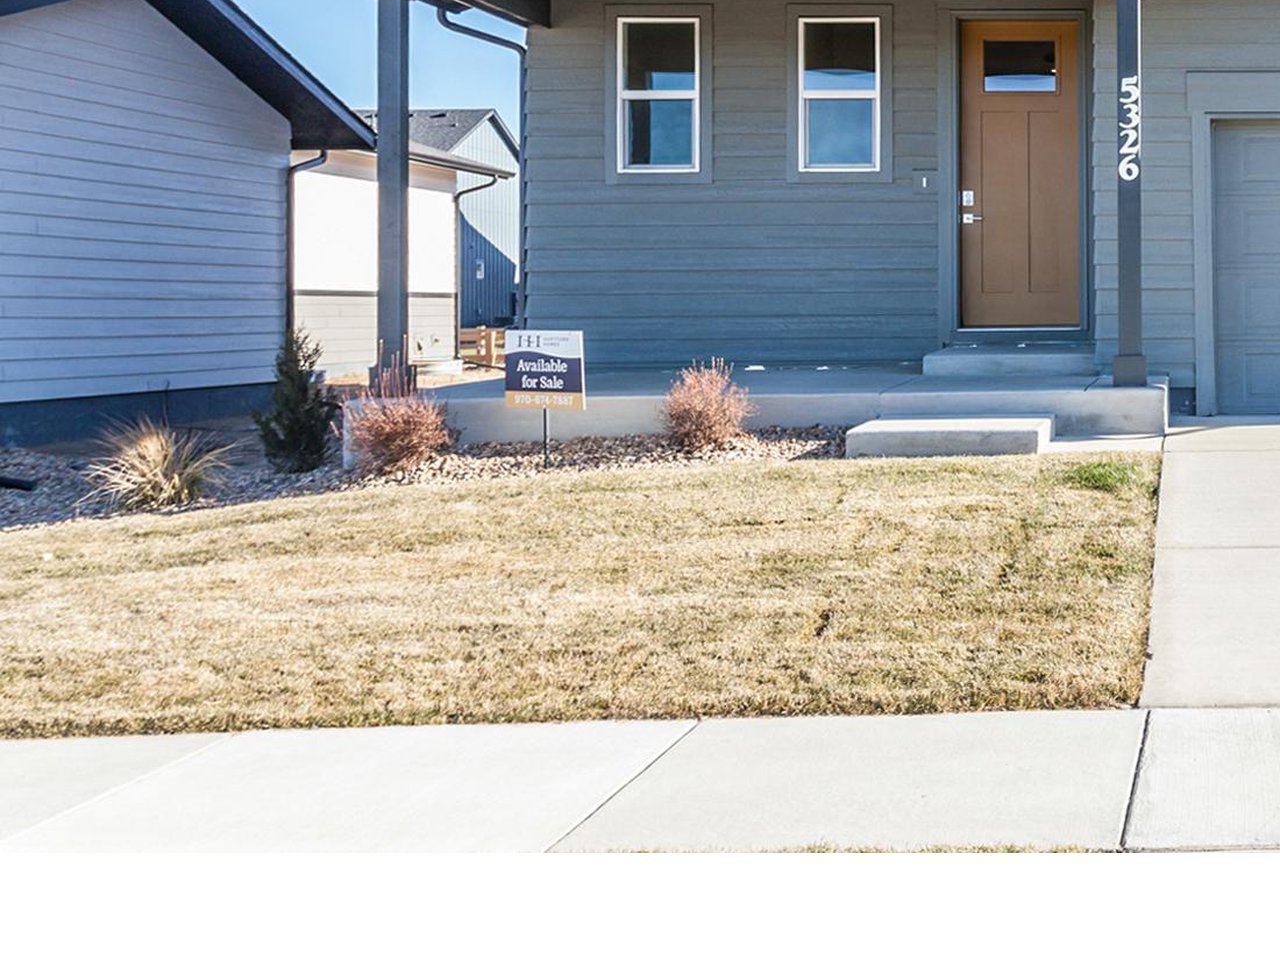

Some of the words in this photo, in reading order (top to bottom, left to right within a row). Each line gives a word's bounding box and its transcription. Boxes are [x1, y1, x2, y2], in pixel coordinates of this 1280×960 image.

[1119, 75, 1140, 181] 5326
[516, 358, 568, 373] Available
[521, 374, 538, 389] for
[540, 375, 564, 389] Sale
